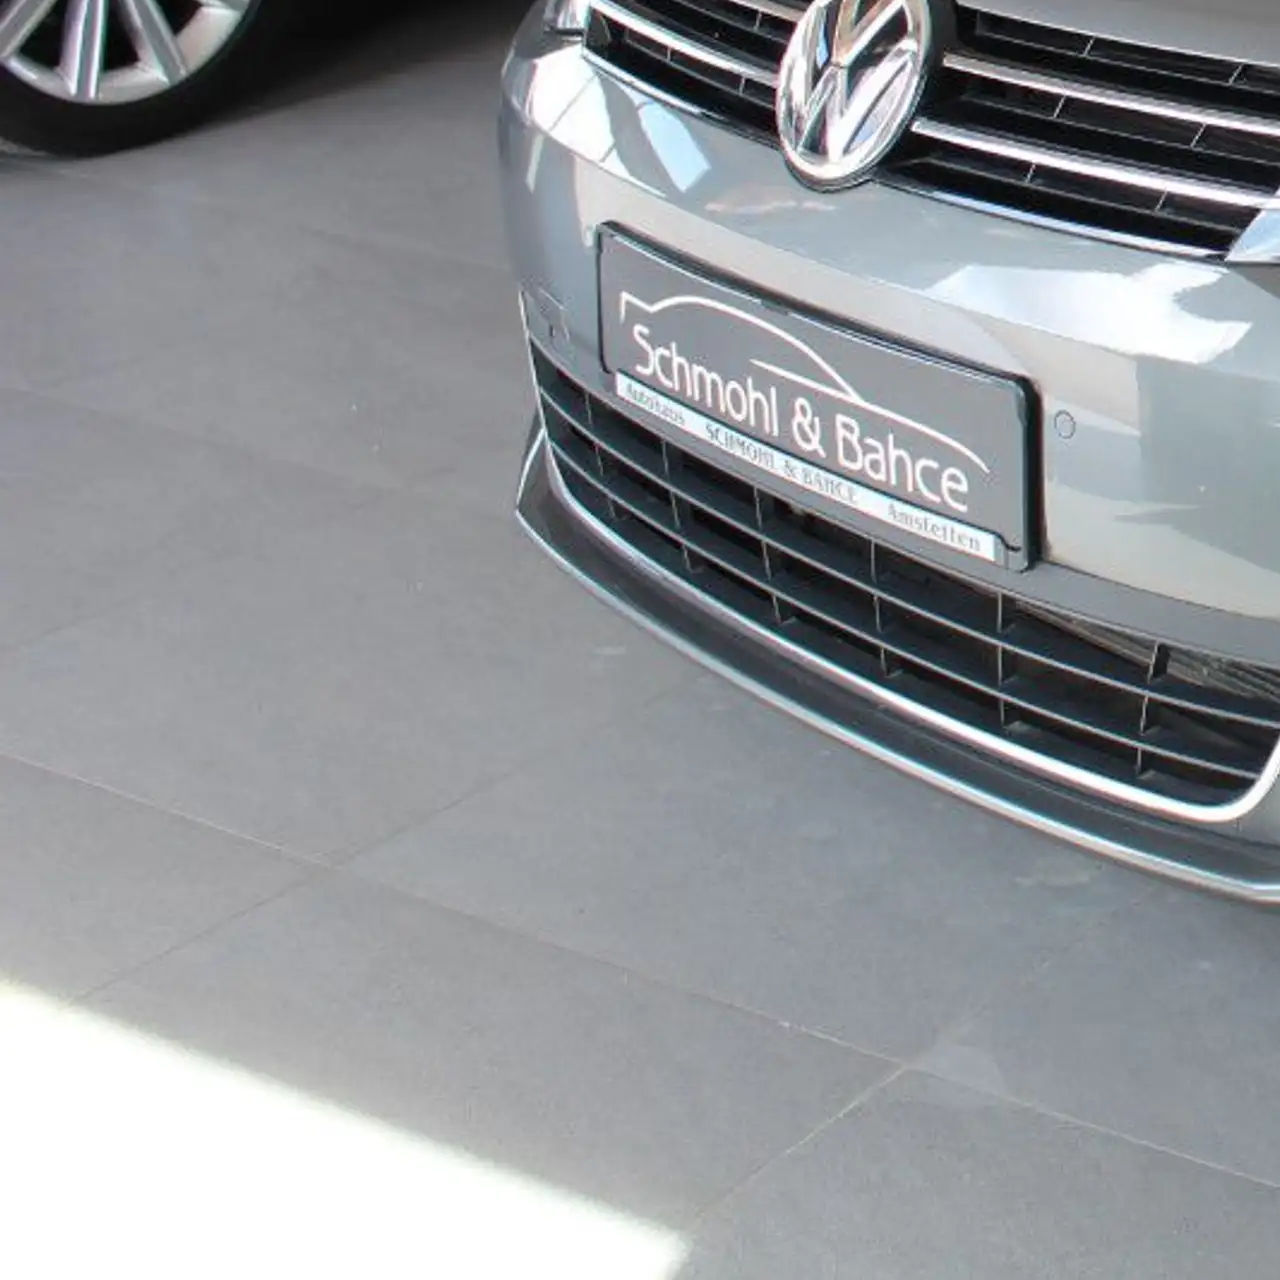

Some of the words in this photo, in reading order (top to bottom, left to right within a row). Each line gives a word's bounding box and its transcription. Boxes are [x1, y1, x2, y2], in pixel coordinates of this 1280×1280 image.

[633, 323, 779, 438] Schmohl
[792, 397, 827, 458] &
[834, 412, 968, 513] Bahce
[704, 422, 777, 470] SCHMOHL
[783, 458, 797, 480] &
[888, 502, 982, 553] Amstetten
